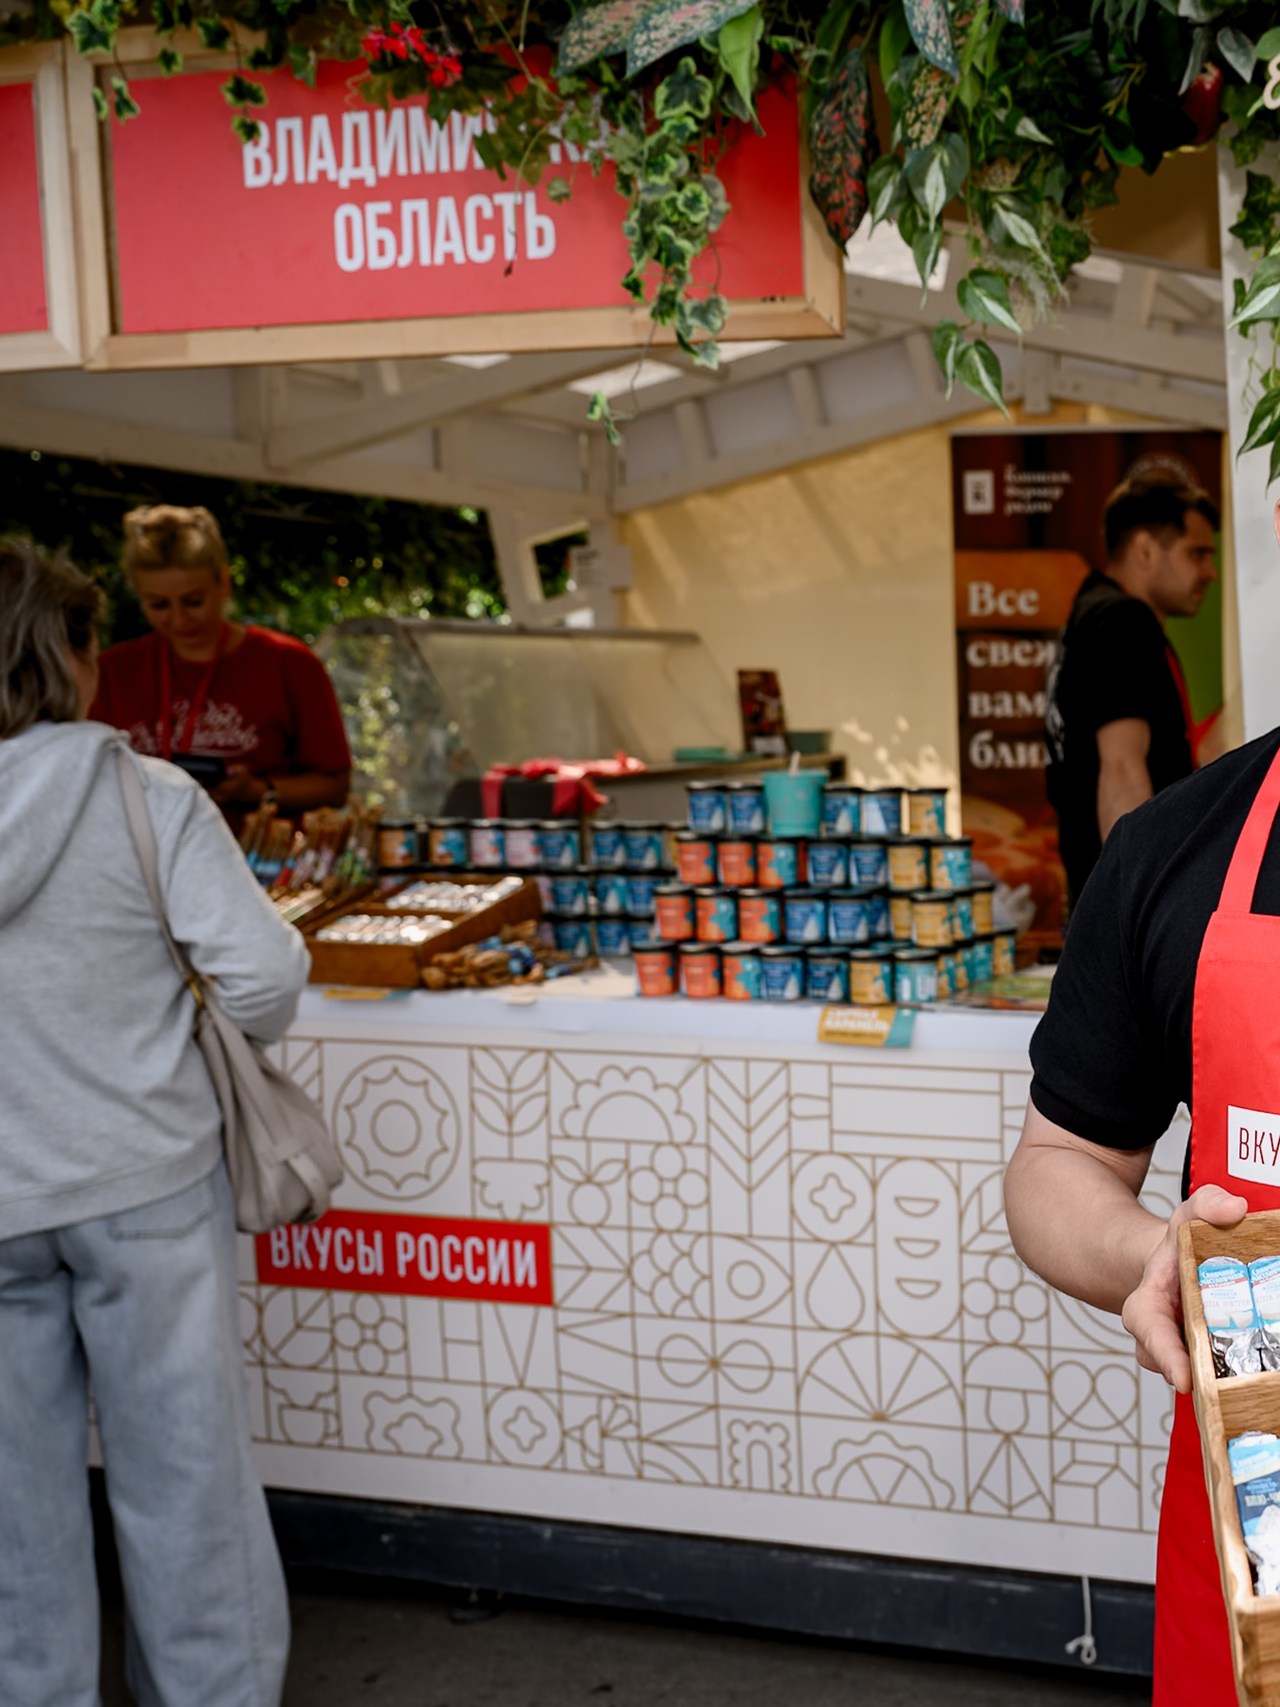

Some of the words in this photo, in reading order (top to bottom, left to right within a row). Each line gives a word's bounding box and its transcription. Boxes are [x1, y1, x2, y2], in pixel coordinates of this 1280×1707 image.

[333, 191, 556, 272] ОБЛАСТЬ
[967, 582, 1040, 616] Все
[269, 1225, 384, 1276] ВКУСЫ
[395, 1231, 539, 1289] РОССИИ
